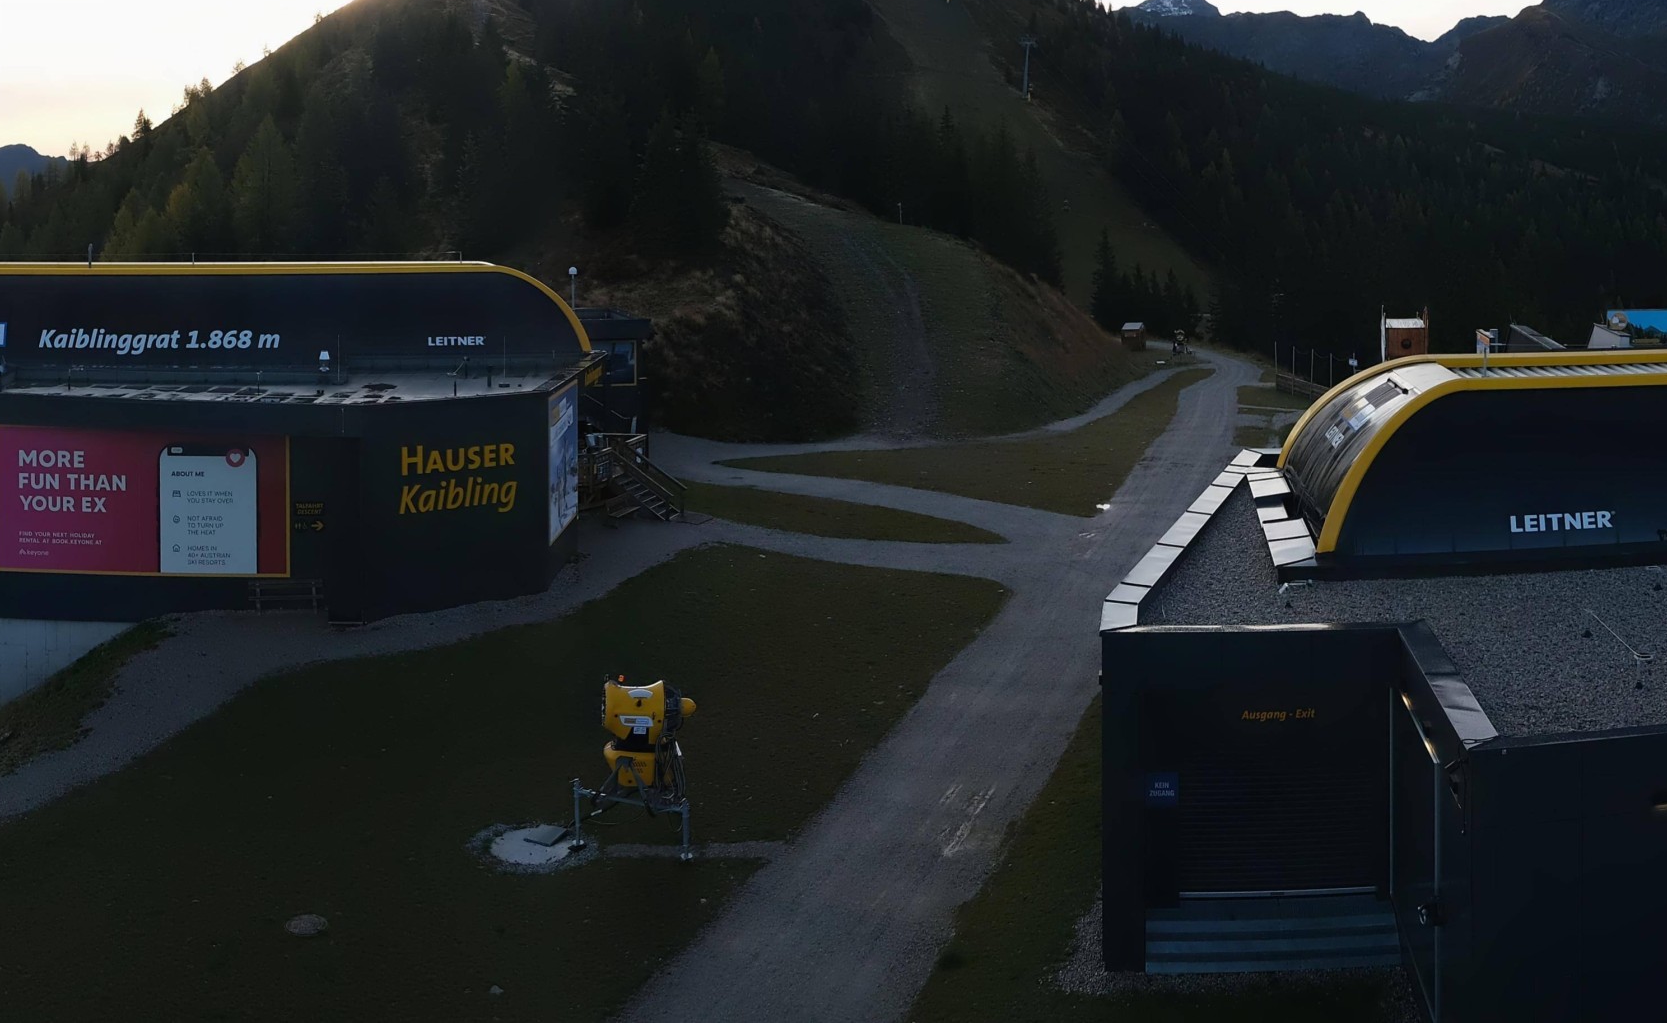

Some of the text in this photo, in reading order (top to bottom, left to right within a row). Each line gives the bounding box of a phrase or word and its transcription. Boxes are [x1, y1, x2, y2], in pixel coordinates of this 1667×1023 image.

[38, 328, 280, 355] Kaiblinggrat 1.868 m
[427, 336, 485, 346] LEITNER
[18, 449, 85, 468] MORE
[401, 443, 516, 476] HAUSER
[18, 473, 127, 491] FUN THAN
[20, 495, 107, 513] YOUR EX
[399, 477, 518, 515] Kaibling
[1509, 511, 1613, 532] LEITNER
[26, 549, 49, 557] keyone
[1241, 709, 1287, 722] Ausgang
[1295, 708, 1315, 719] Exit
[1149, 789, 1175, 797] ZUGANG
